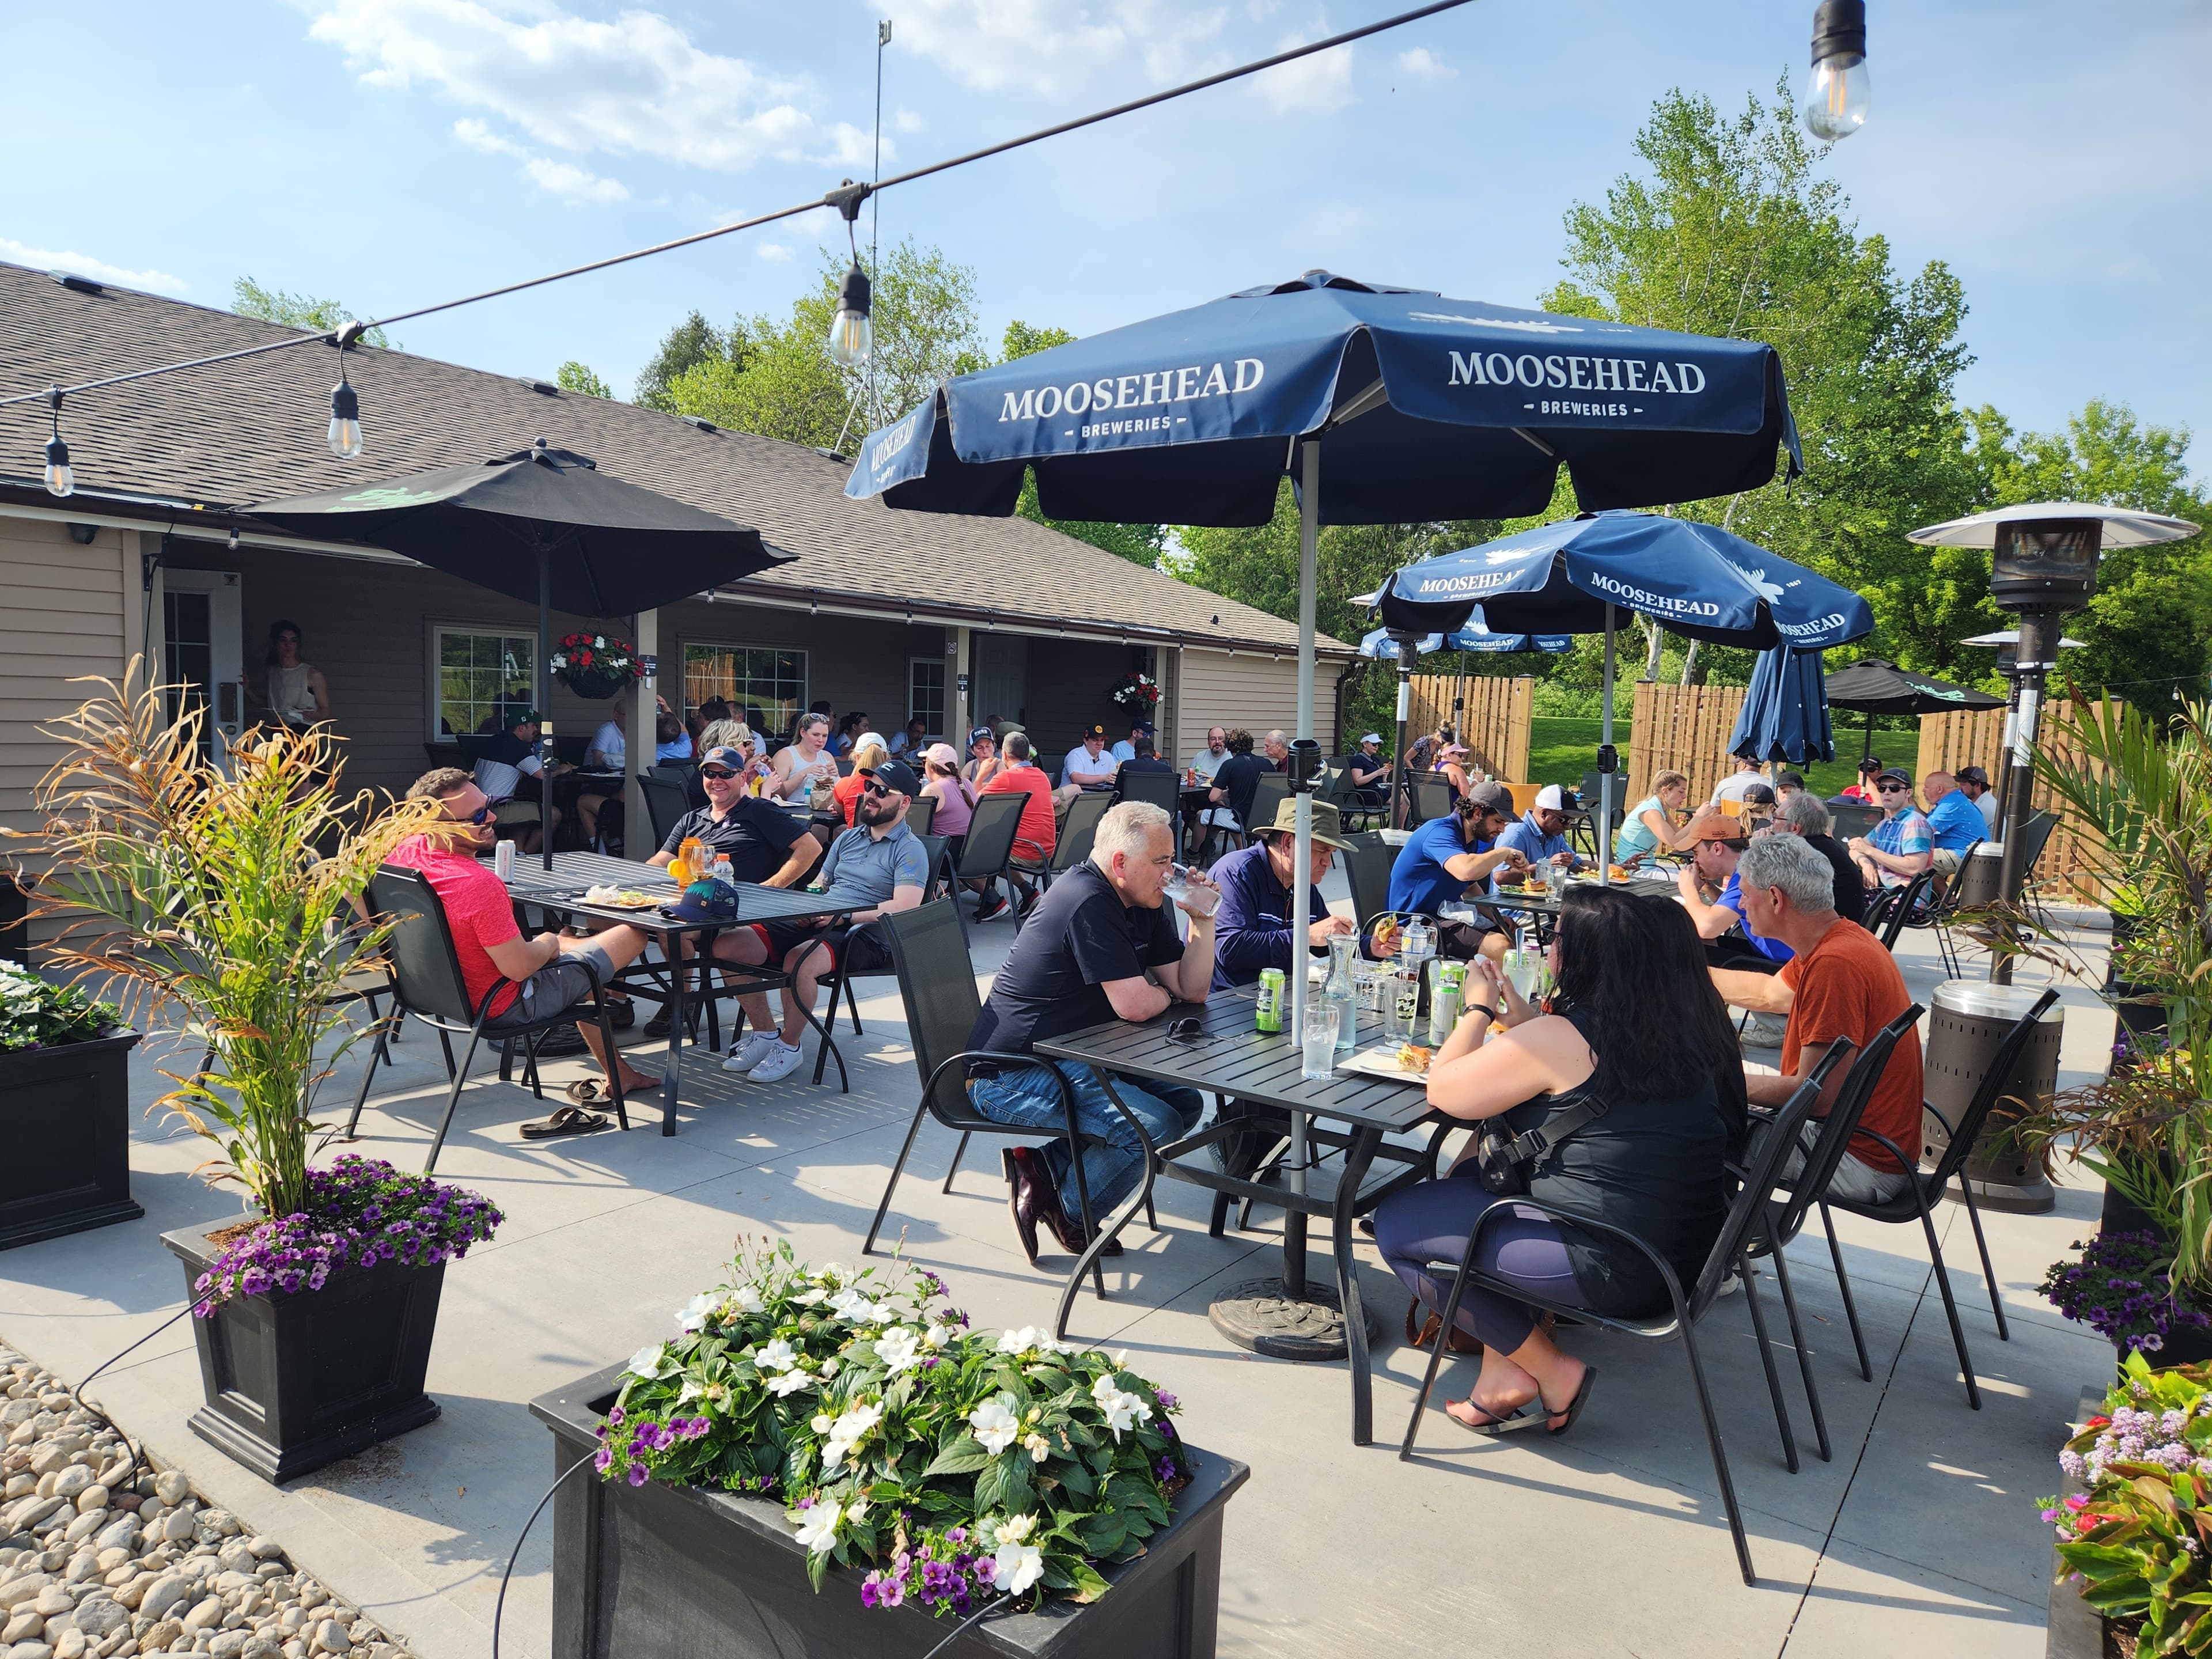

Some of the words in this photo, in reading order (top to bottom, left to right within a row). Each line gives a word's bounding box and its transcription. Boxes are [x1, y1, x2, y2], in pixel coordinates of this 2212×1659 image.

[1448, 350, 1706, 394] MOOSEHEAD
[998, 358, 1264, 423] MOOSEHEAD
[1541, 400, 1628, 416] BREWERIES
[1081, 416, 1172, 438] BREWERIES
[1786, 579, 1802, 588] 1867
[1591, 572, 1719, 616] MOOSEHEAD
[1630, 603, 1674, 618] BREWERIES
[1459, 639, 1514, 647] MOOSEHEAD
